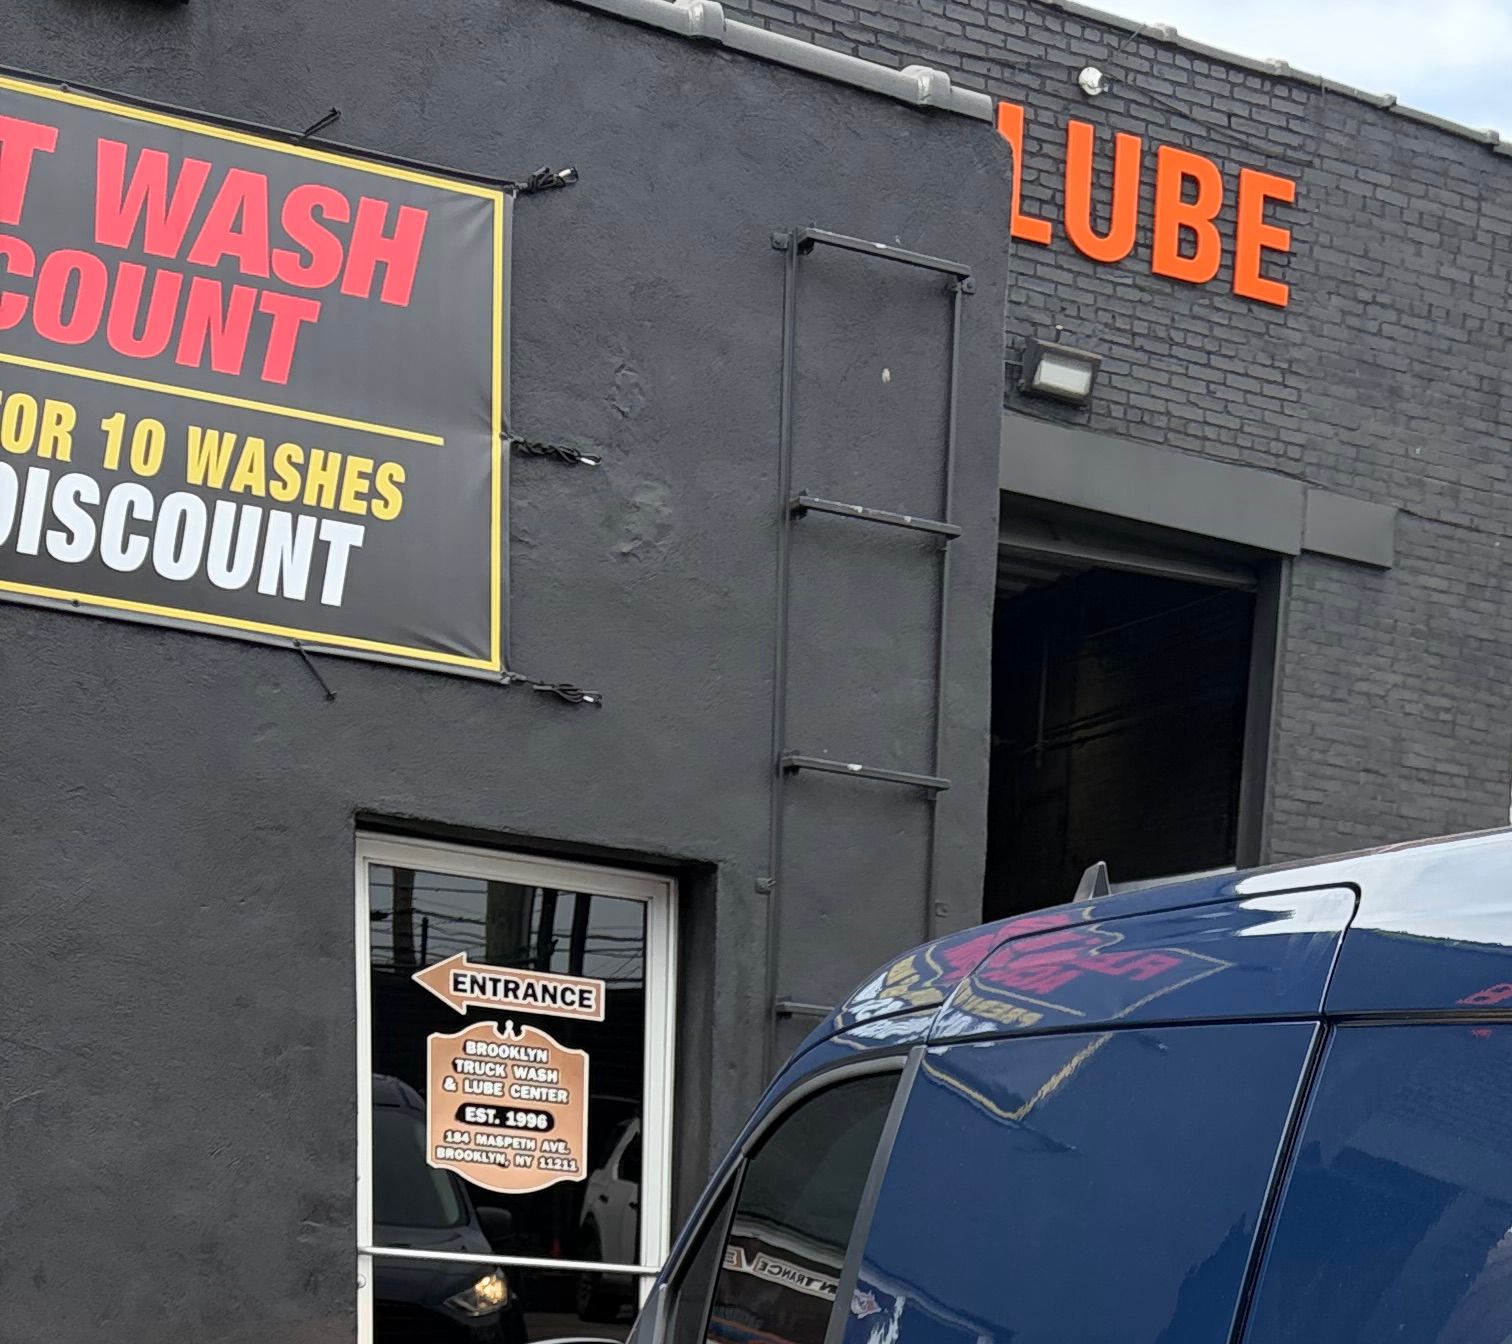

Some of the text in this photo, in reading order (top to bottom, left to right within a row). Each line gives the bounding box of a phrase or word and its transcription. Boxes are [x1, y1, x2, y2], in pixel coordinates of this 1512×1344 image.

[996, 101, 1296, 308] LUBE
[94, 137, 429, 307] WASH
[0, 390, 406, 521] OR 10 WASHES
[451, 972, 595, 1009] ENTRANCE
[464, 1040, 549, 1063] BROOKLYN
[453, 1058, 559, 1083] TRUCK WASH
[443, 1076, 569, 1104] & LUBE CENTER
[464, 1106, 548, 1130] EST. 1996
[475, 1133, 536, 1150] MASPETH
[436, 1147, 578, 1172] BROOKLYN, NY 11211
